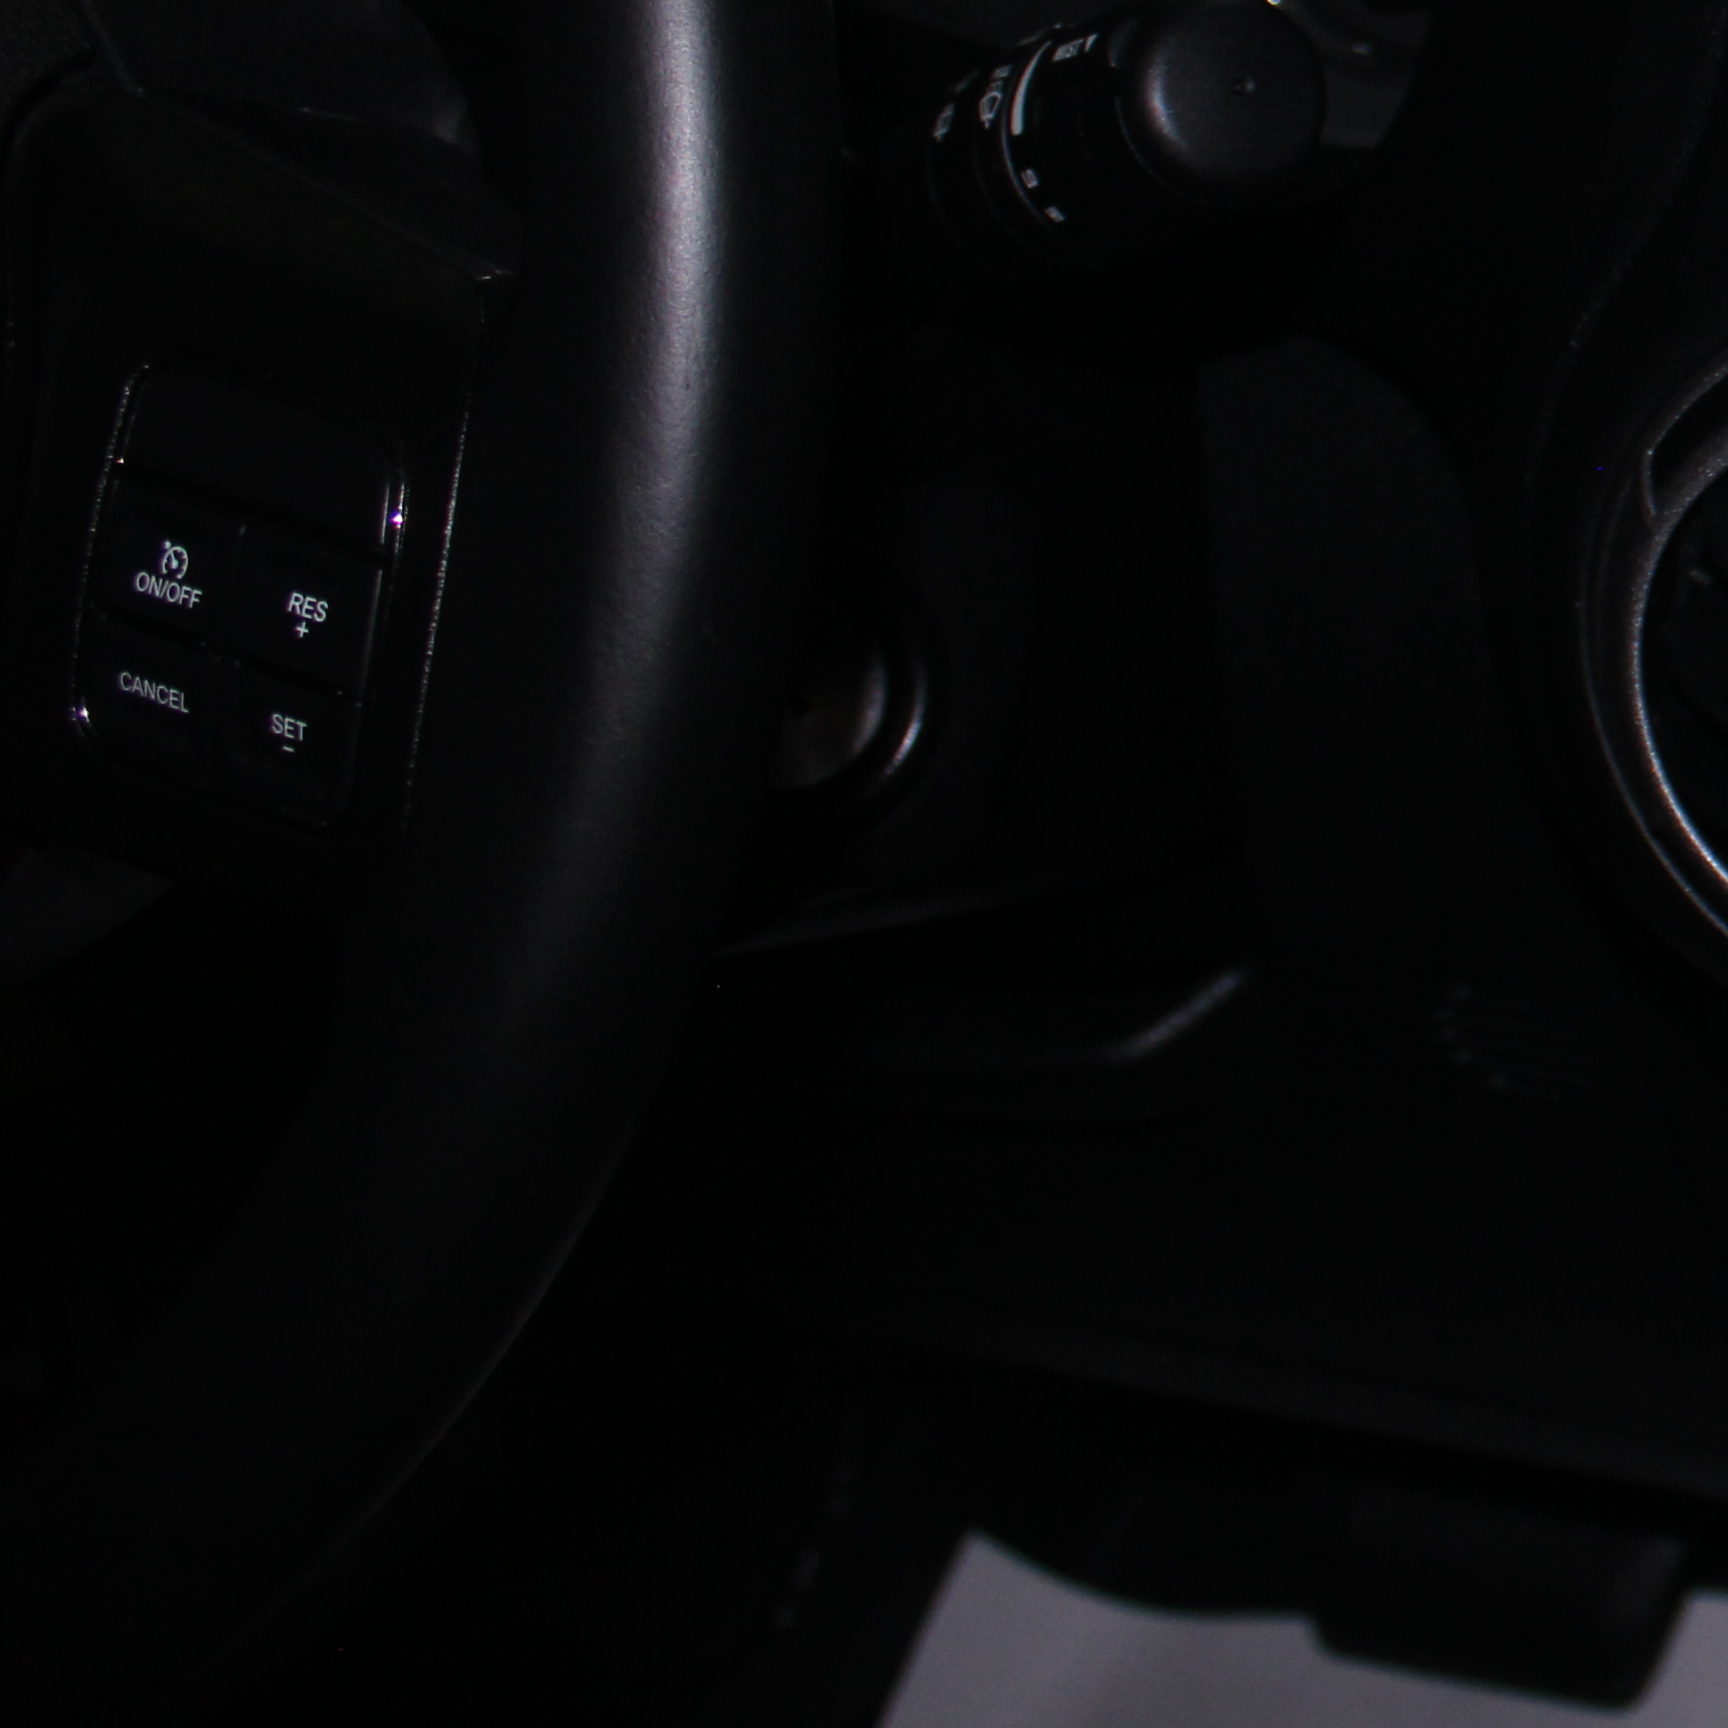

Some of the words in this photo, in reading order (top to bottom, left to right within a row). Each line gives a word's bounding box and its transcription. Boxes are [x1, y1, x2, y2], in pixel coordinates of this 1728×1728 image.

[134, 571, 203, 609] ON/OFF
[287, 592, 330, 623] RES
[119, 671, 191, 714] CANCEL
[271, 713, 308, 742] SET
